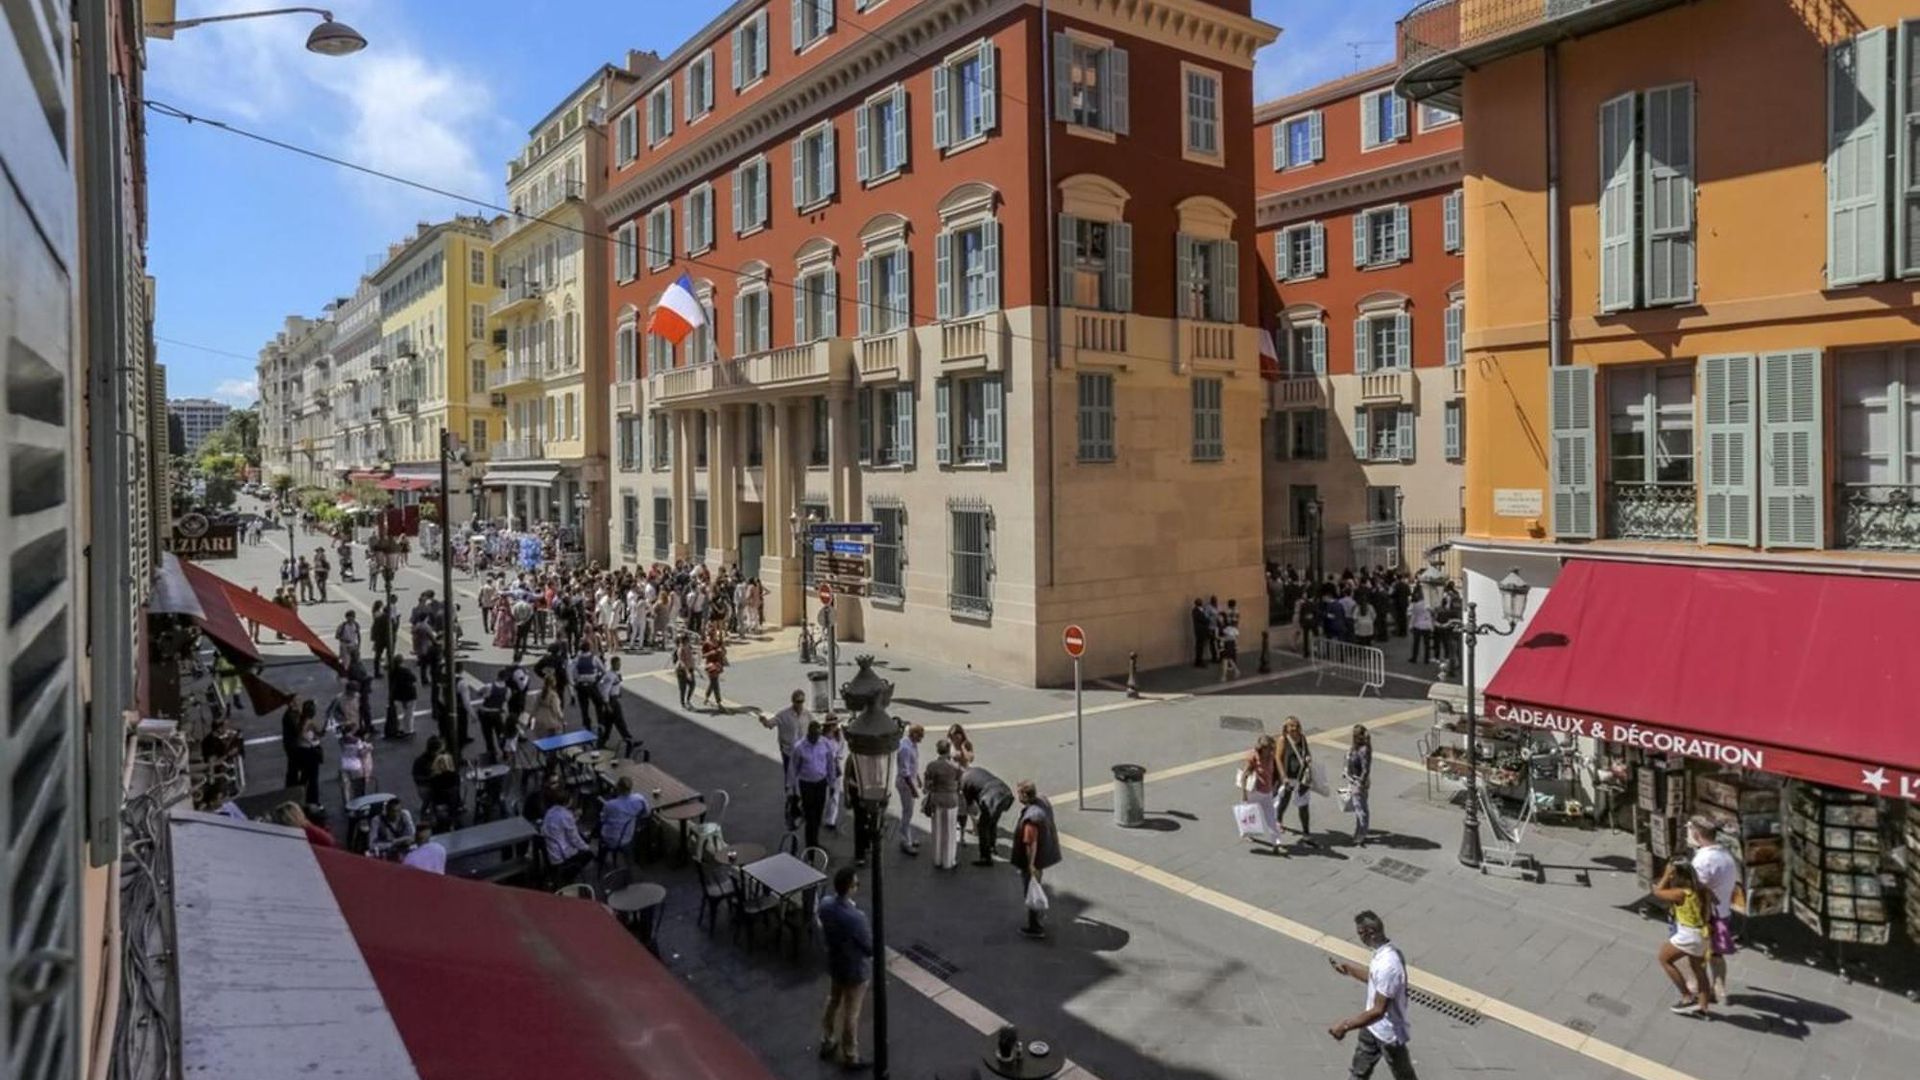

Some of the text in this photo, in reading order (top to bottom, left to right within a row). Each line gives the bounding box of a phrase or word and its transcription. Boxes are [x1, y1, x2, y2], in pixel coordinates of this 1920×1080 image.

[1494, 704, 1763, 769] CADEAUX & DÉCORATION
